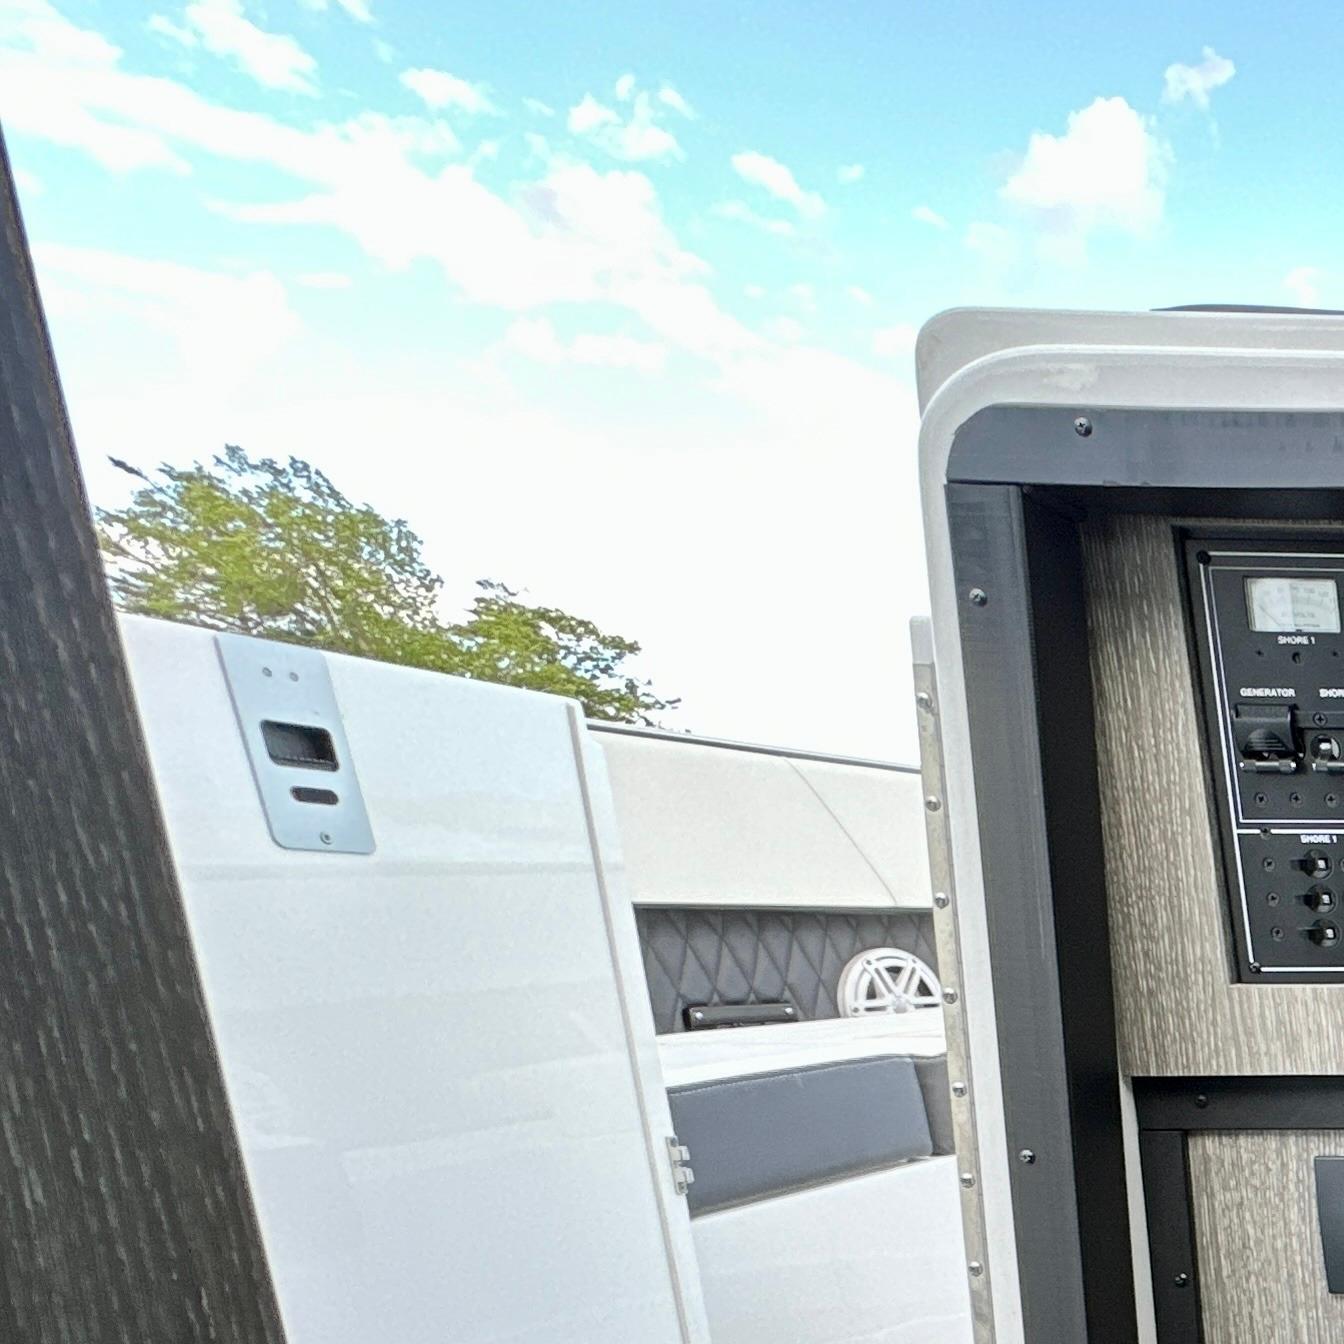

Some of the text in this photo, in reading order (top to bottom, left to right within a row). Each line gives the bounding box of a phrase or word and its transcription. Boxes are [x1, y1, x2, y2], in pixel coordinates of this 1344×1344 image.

[1278, 636, 1315, 644] SHORE 1
[1240, 688, 1296, 697] GENERATOR
[1300, 835, 1331, 843] SHORE
